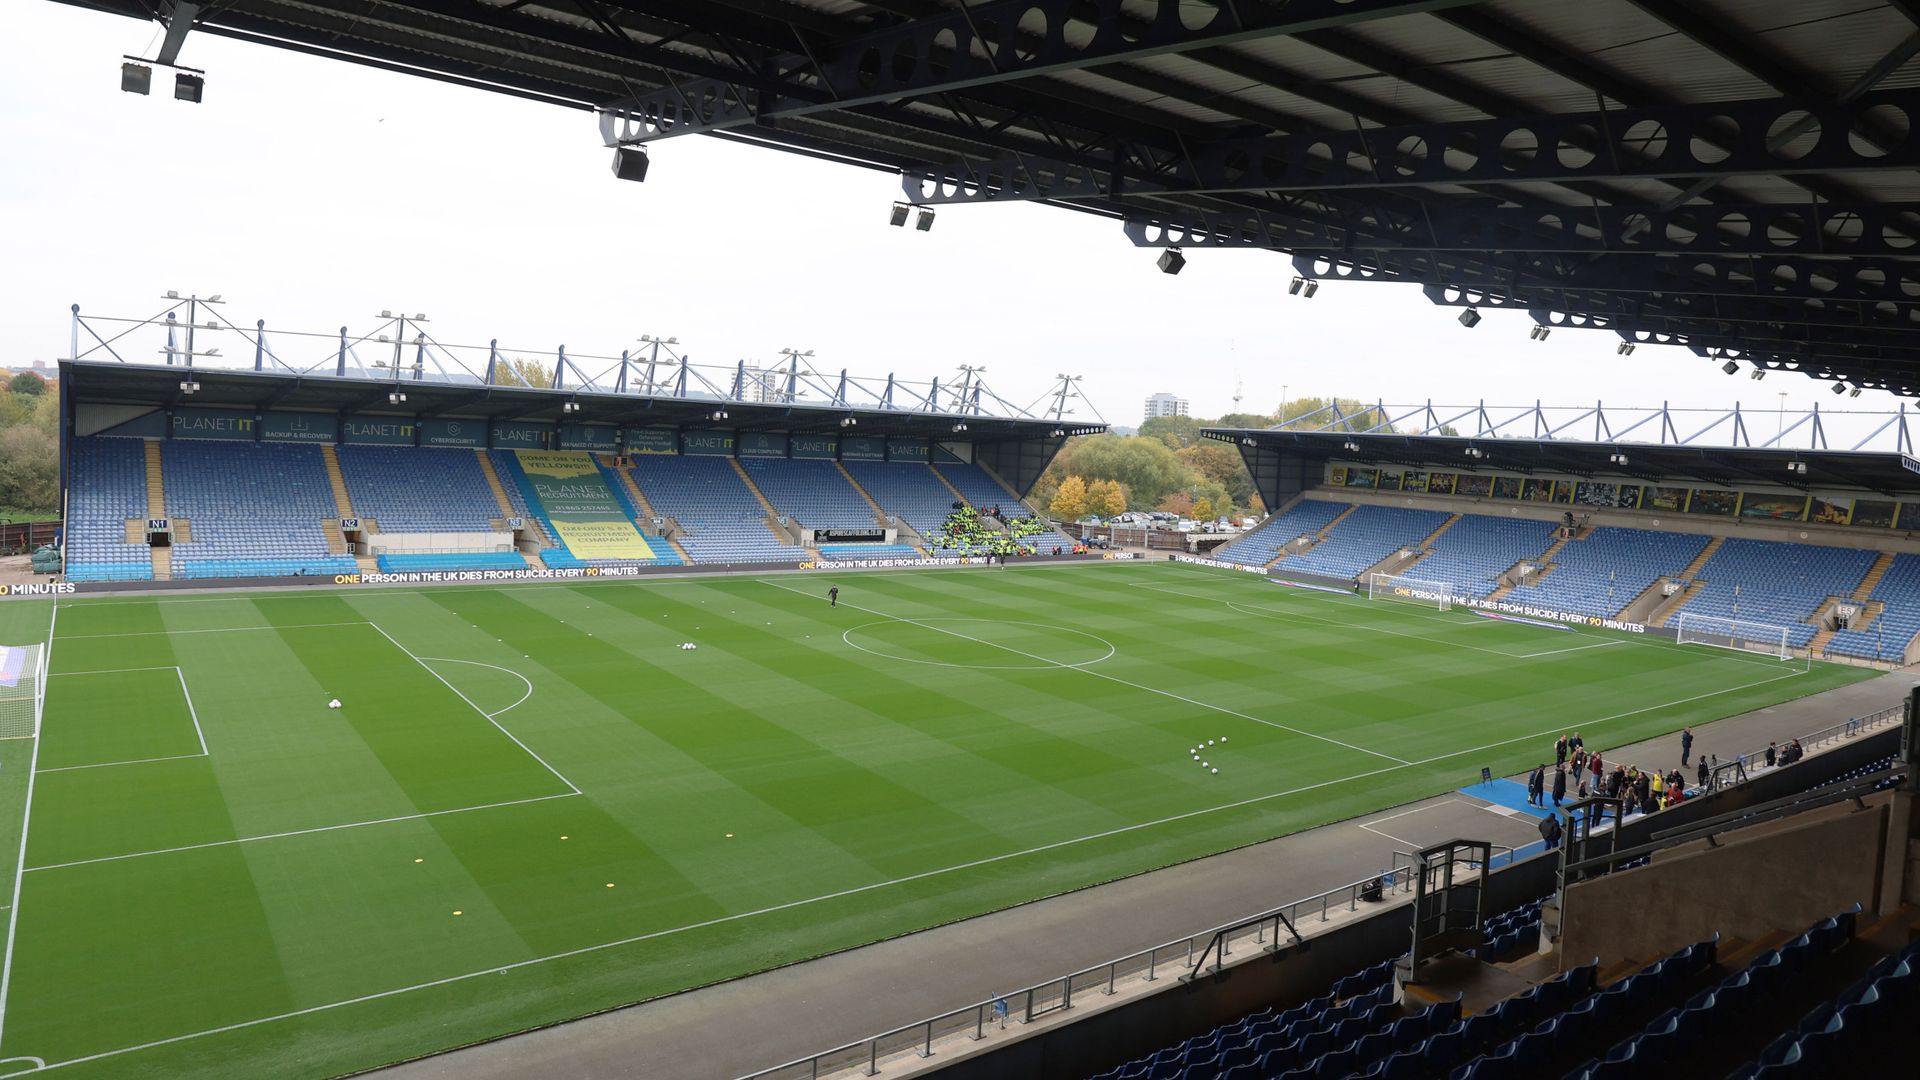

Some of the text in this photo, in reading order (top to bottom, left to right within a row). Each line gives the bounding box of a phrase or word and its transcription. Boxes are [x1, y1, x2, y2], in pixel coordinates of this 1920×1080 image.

[173, 417, 254, 432] PLANET IT
[344, 424, 414, 437] PLANET IT
[723, 438, 734, 448] IT
[535, 484, 605, 493] PLANET
[152, 520, 165, 528] N1
[798, 561, 816, 570] ONE
[816, 560, 846, 569] PERSON
[846, 560, 855, 569] IN
[855, 560, 868, 568] THE
[868, 559, 878, 568] UK
[878, 559, 894, 567] DIES
[894, 558, 914, 567] FROM
[915, 558, 940, 567] SUICIDE
[940, 557, 960, 565] EVERY
[961, 556, 969, 565] 90
[1217, 560, 1234, 570] EVERY
[1234, 563, 1243, 571] 90
[1243, 564, 1268, 575] MINUTES
[334, 566, 639, 584] ONE PERSON IN THE UK DIES FROM SUICIDE EVERY 90 MINUTES
[11, 583, 76, 595] MINUTES
[1394, 587, 1645, 633] ONE PERSON IN THE UK DIES FROM SUICIDE EVERY 90 MINUTES
